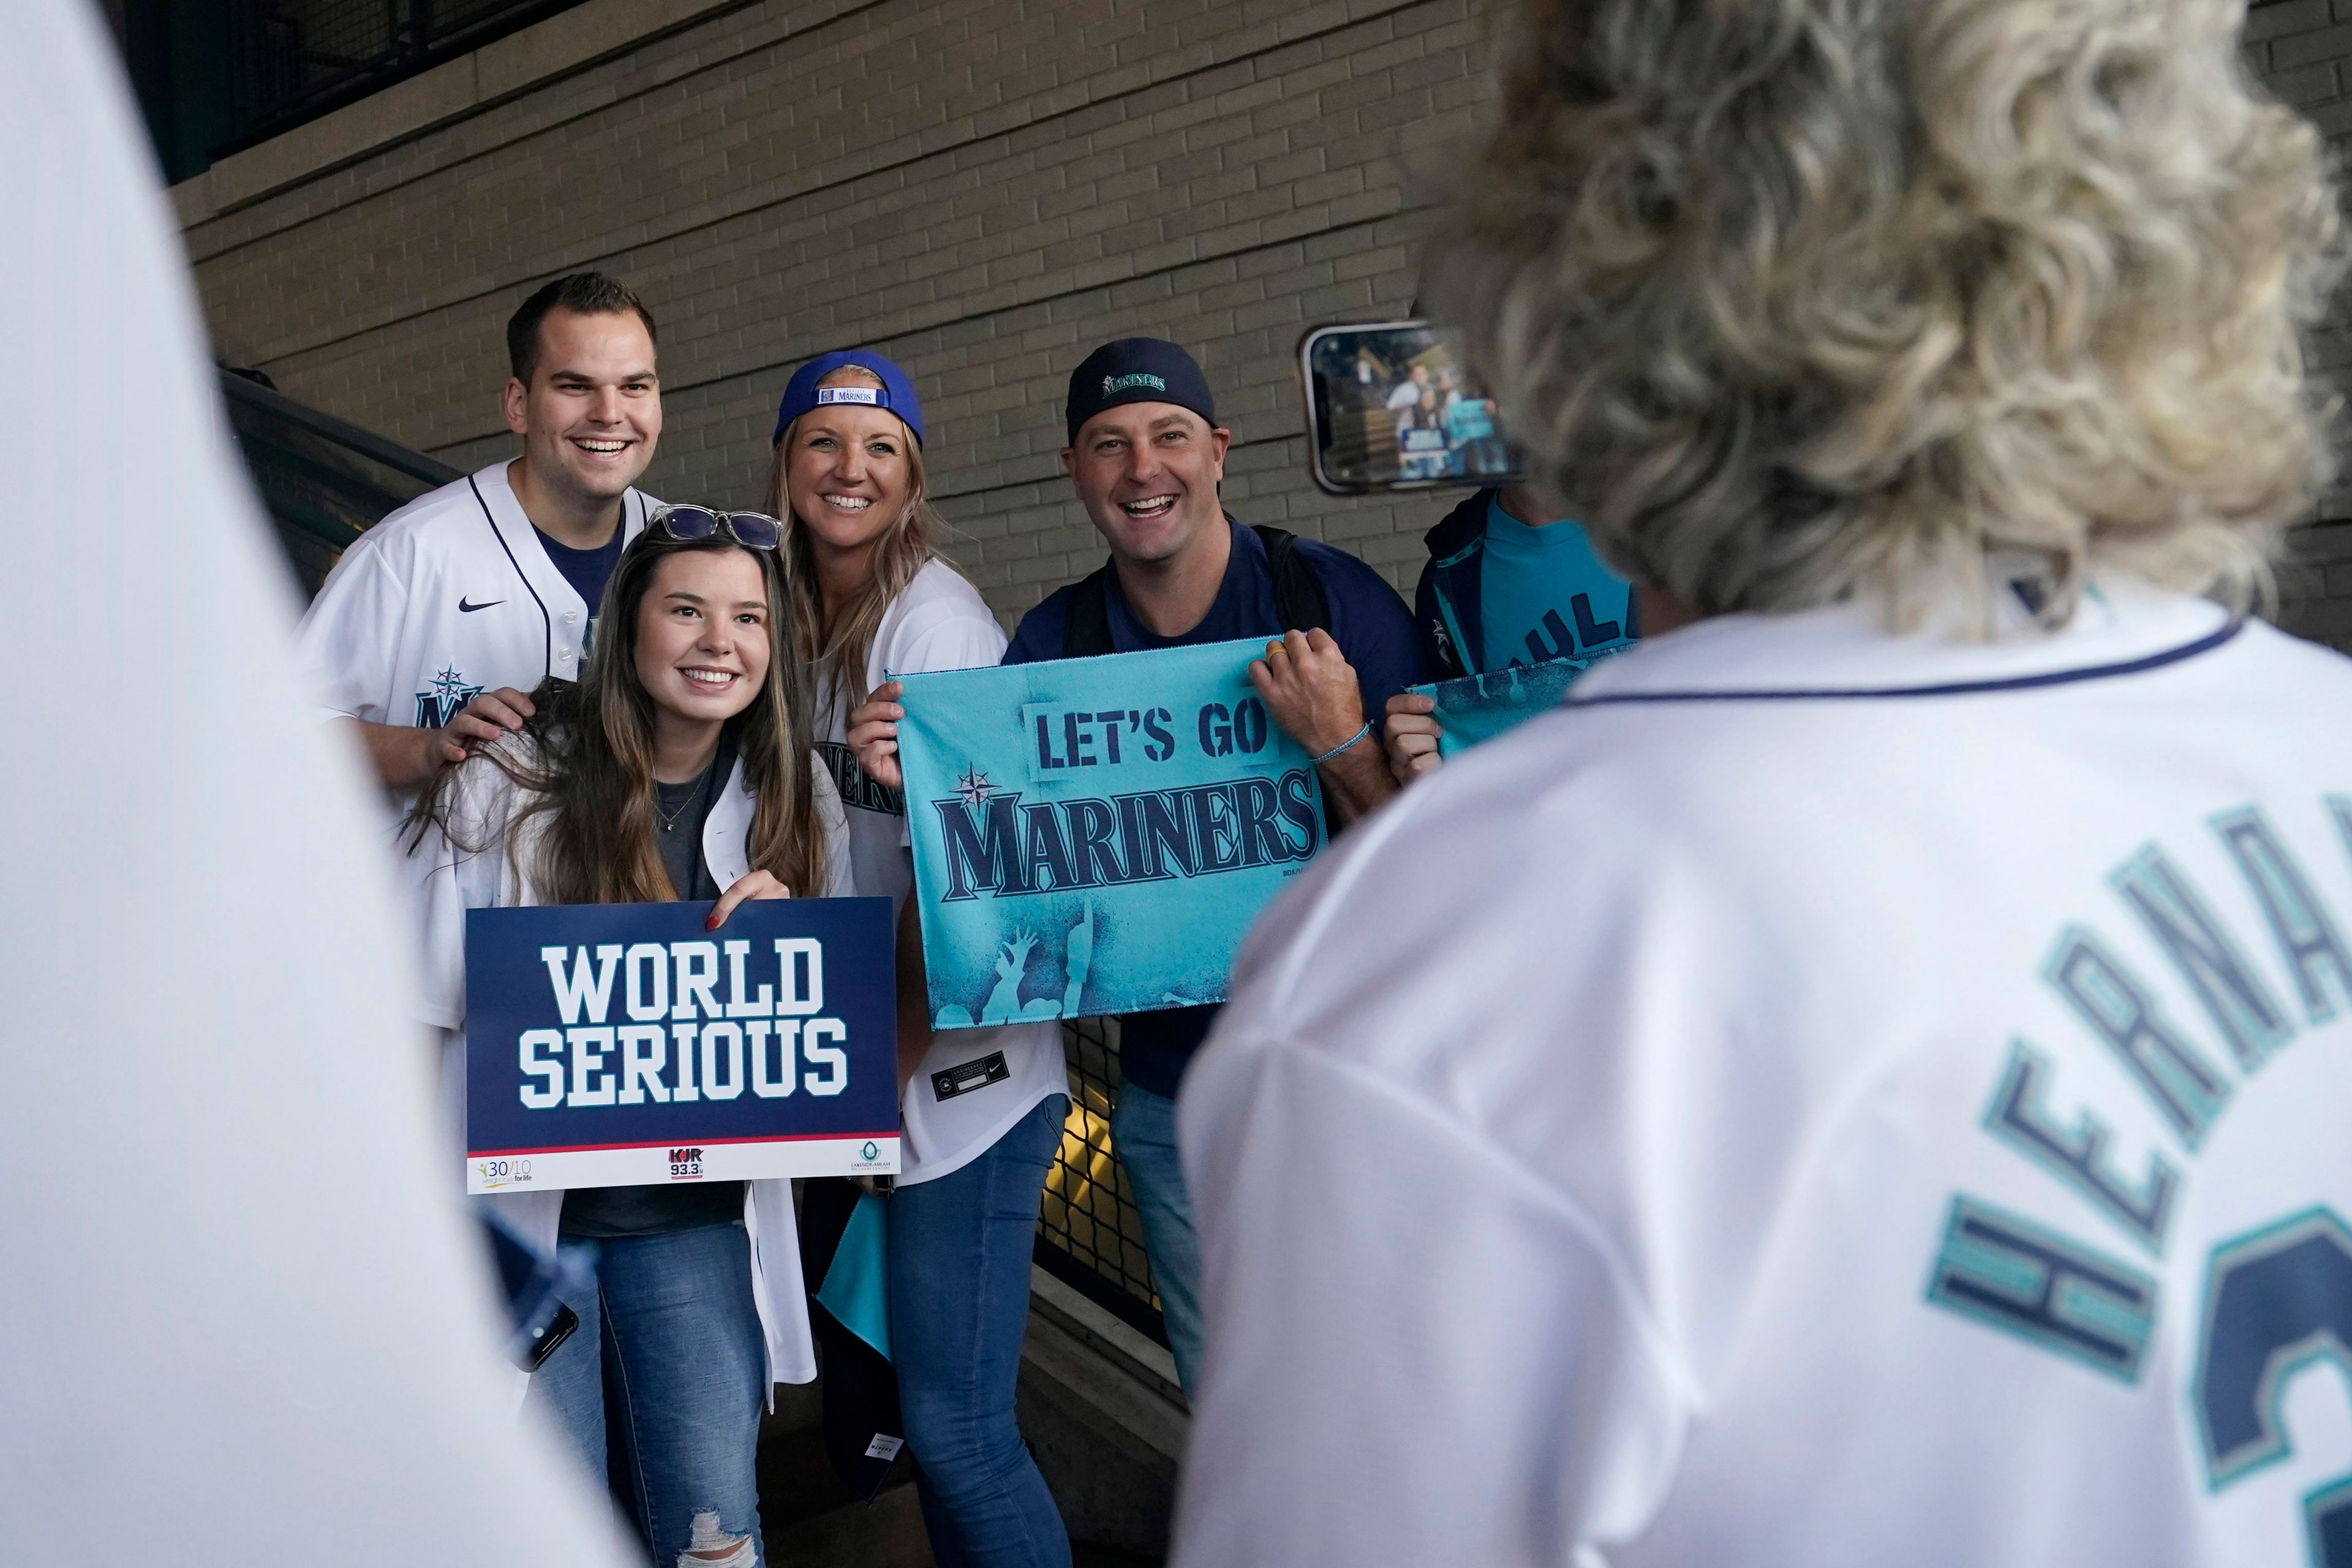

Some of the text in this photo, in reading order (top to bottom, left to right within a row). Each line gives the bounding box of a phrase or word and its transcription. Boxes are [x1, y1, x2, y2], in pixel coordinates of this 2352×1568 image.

[839, 392, 871, 401] MARINERS
[1102, 374, 1166, 399] MARINERS
[1036, 697, 1267, 769] LET'S GO
[930, 767, 1319, 903] MARINERS
[541, 937, 823, 1025] WORLD
[519, 1017, 848, 1109] SERIOUS
[1922, 792, 2352, 1387] HERNA
[669, 1148, 704, 1163] KJR
[671, 1164, 699, 1175] 93.3
